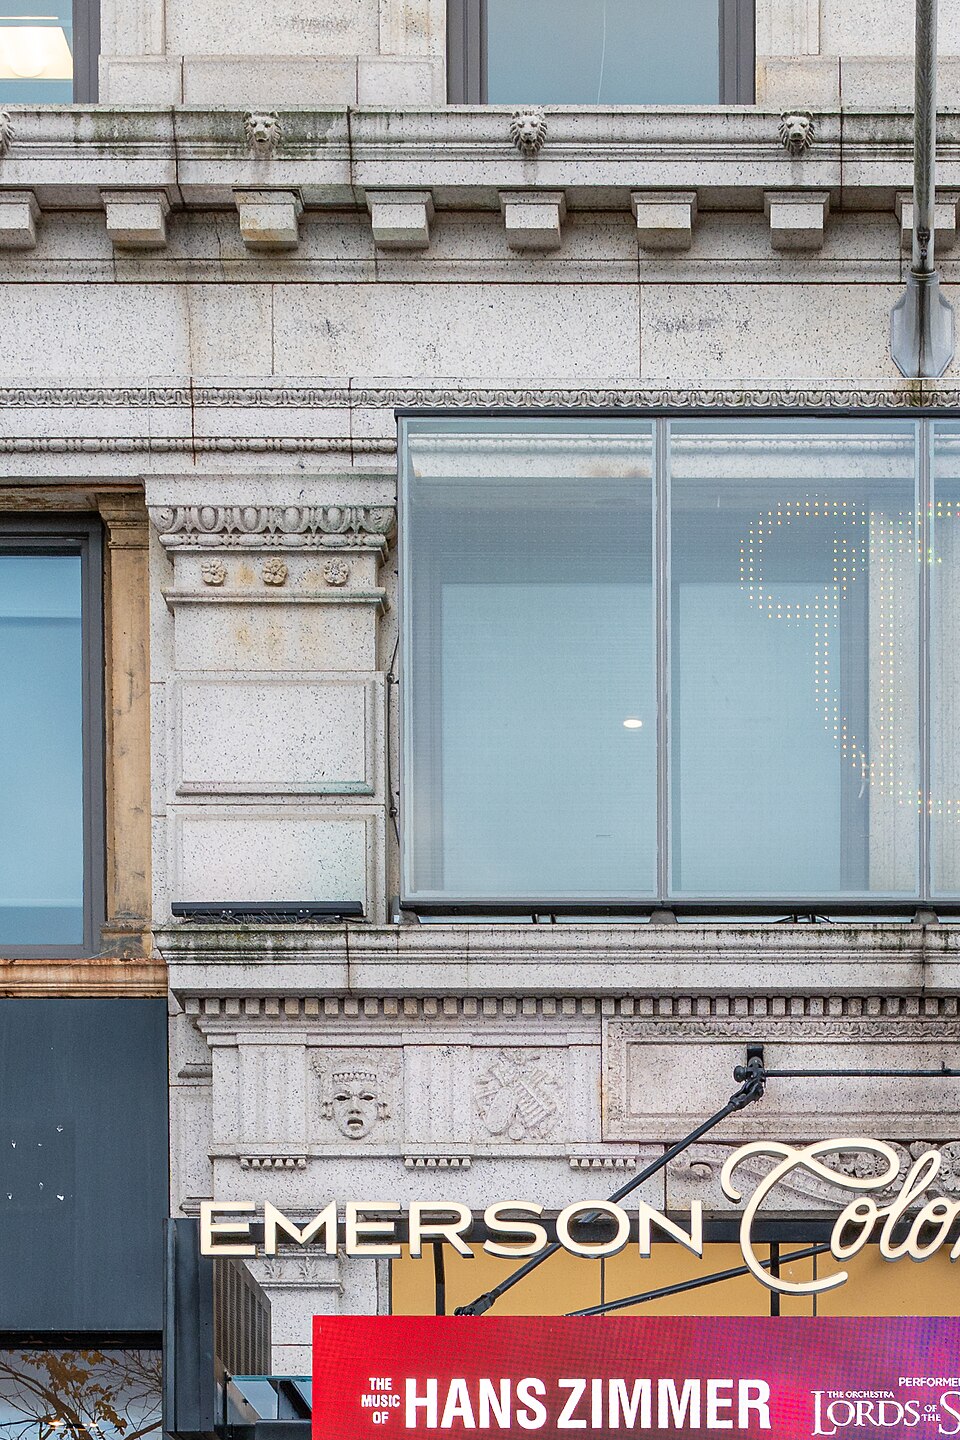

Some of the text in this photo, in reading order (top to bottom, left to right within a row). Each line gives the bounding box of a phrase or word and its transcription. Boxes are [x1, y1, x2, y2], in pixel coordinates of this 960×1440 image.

[200, 1200, 703, 1260] EMERSON
[369, 1377, 392, 1391] THE
[361, 1394, 400, 1408] MUSIC
[827, 1390, 895, 1398] THE ORCHESTRA
[405, 1377, 772, 1430] HANS ZIMMER
[924, 1404, 938, 1413] OF
[372, 1411, 389, 1424] OF
[811, 1390, 921, 1436] LORDS
[921, 1413, 941, 1422] THE
